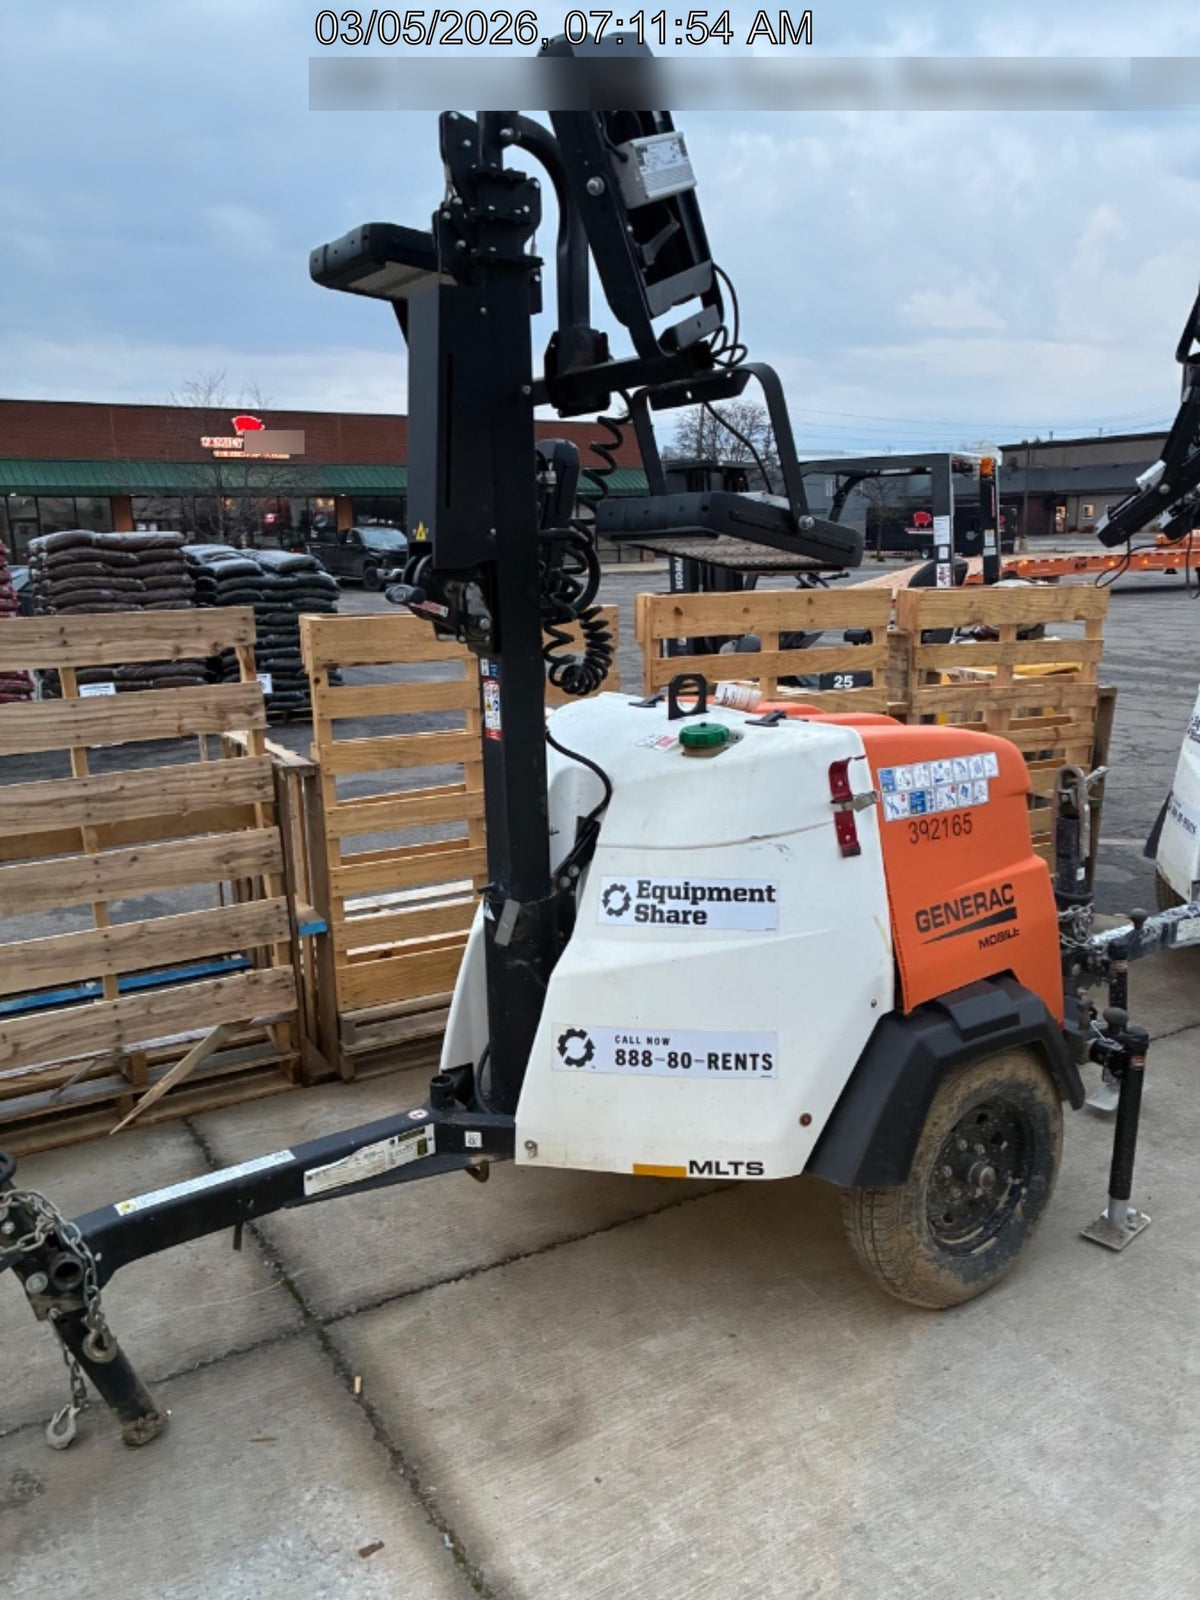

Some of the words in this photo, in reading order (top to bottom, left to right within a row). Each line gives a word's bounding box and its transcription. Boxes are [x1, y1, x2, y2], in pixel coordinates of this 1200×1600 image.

[833, 674, 854, 689] 25
[908, 812, 973, 844] 392165
[636, 880, 776, 905] Equipment
[634, 903, 708, 925] Share
[915, 883, 1015, 933] GENERAC
[978, 927, 1020, 950] MOBILE
[614, 1034, 641, 1045] CALL
[646, 1036, 670, 1046] NOW
[614, 1048, 773, 1071] 888-80-RENTS
[689, 1160, 764, 1176] MLTS
